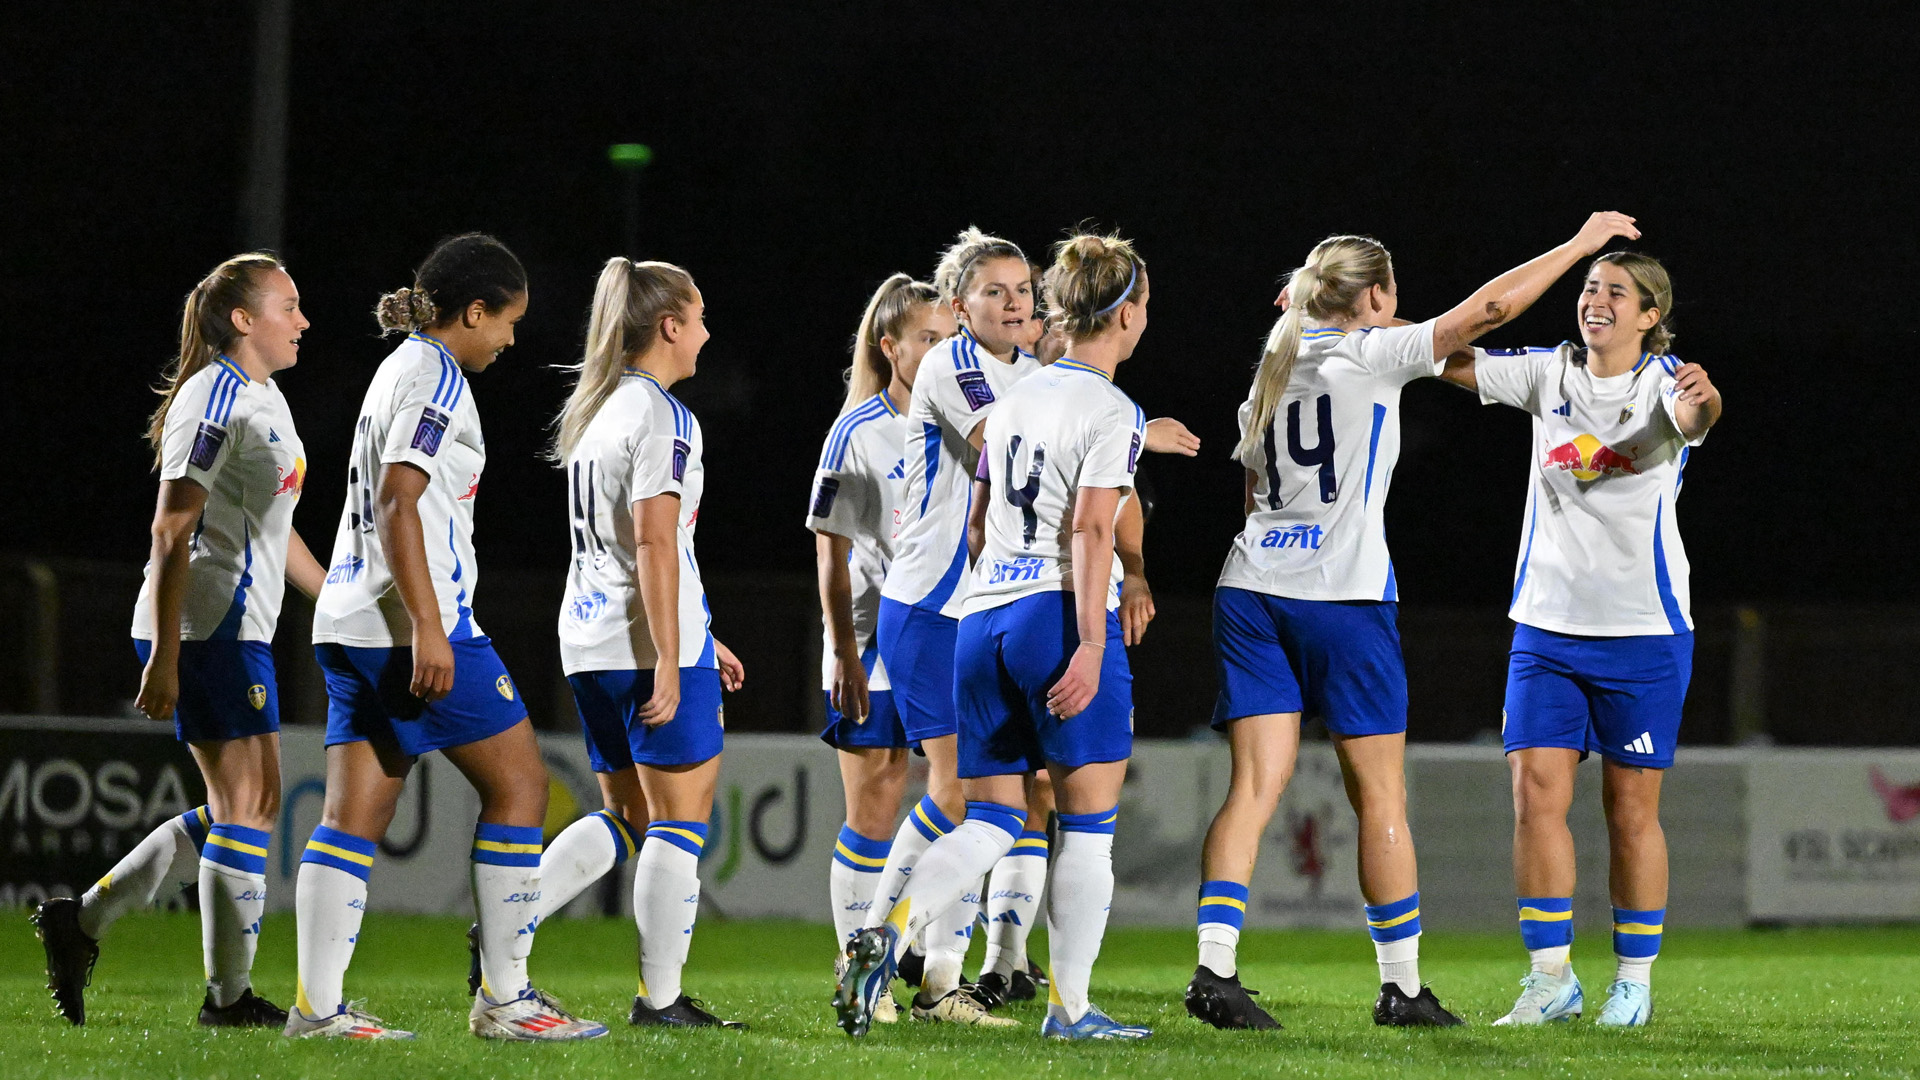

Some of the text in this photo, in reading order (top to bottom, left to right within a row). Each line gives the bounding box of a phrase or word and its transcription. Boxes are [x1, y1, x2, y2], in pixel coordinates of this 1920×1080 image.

[1263, 394, 1338, 511] 14
[1006, 434, 1047, 550] 4
[989, 557, 1046, 584] amt
[1261, 524, 1323, 549] amt
